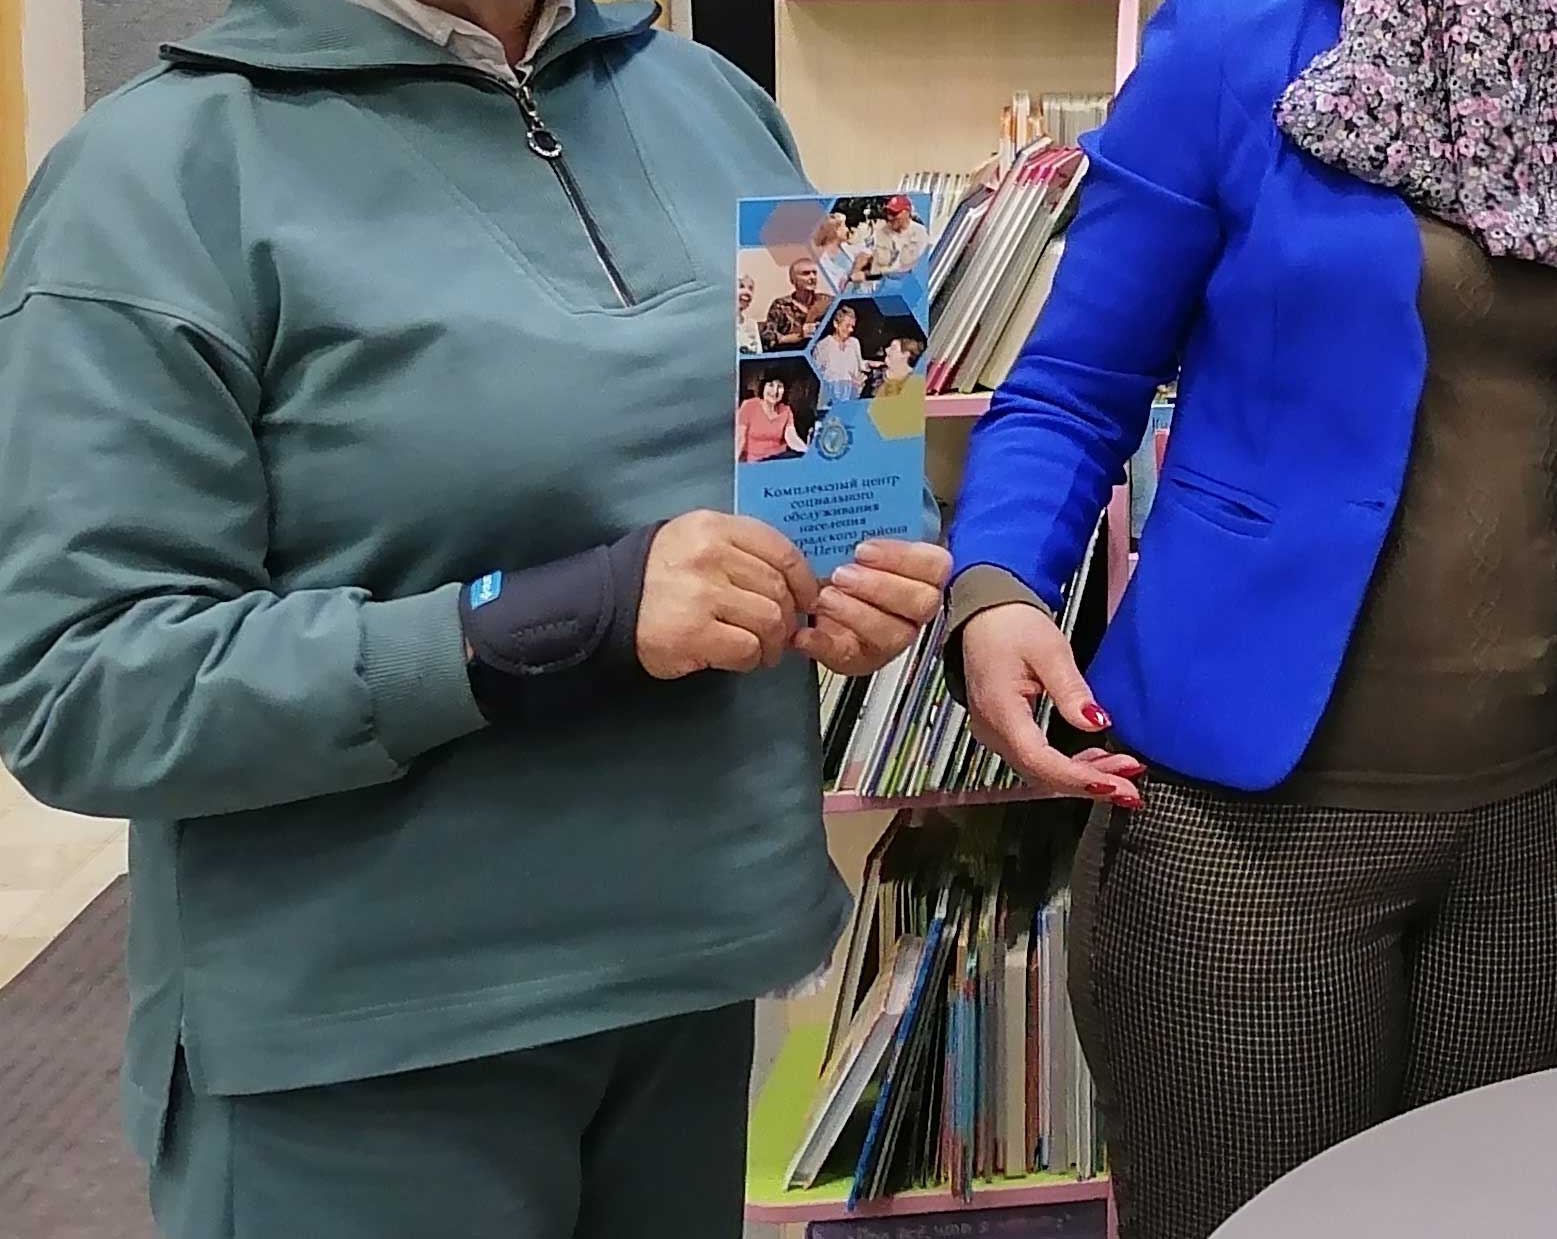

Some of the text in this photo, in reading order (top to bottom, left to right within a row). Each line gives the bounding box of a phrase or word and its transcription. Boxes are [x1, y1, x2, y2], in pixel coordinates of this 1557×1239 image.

[763, 474, 900, 499] Комплексный центр
[790, 490, 874, 510] социального
[783, 503, 880, 522] обслуживания
[799, 517, 867, 534] населения
